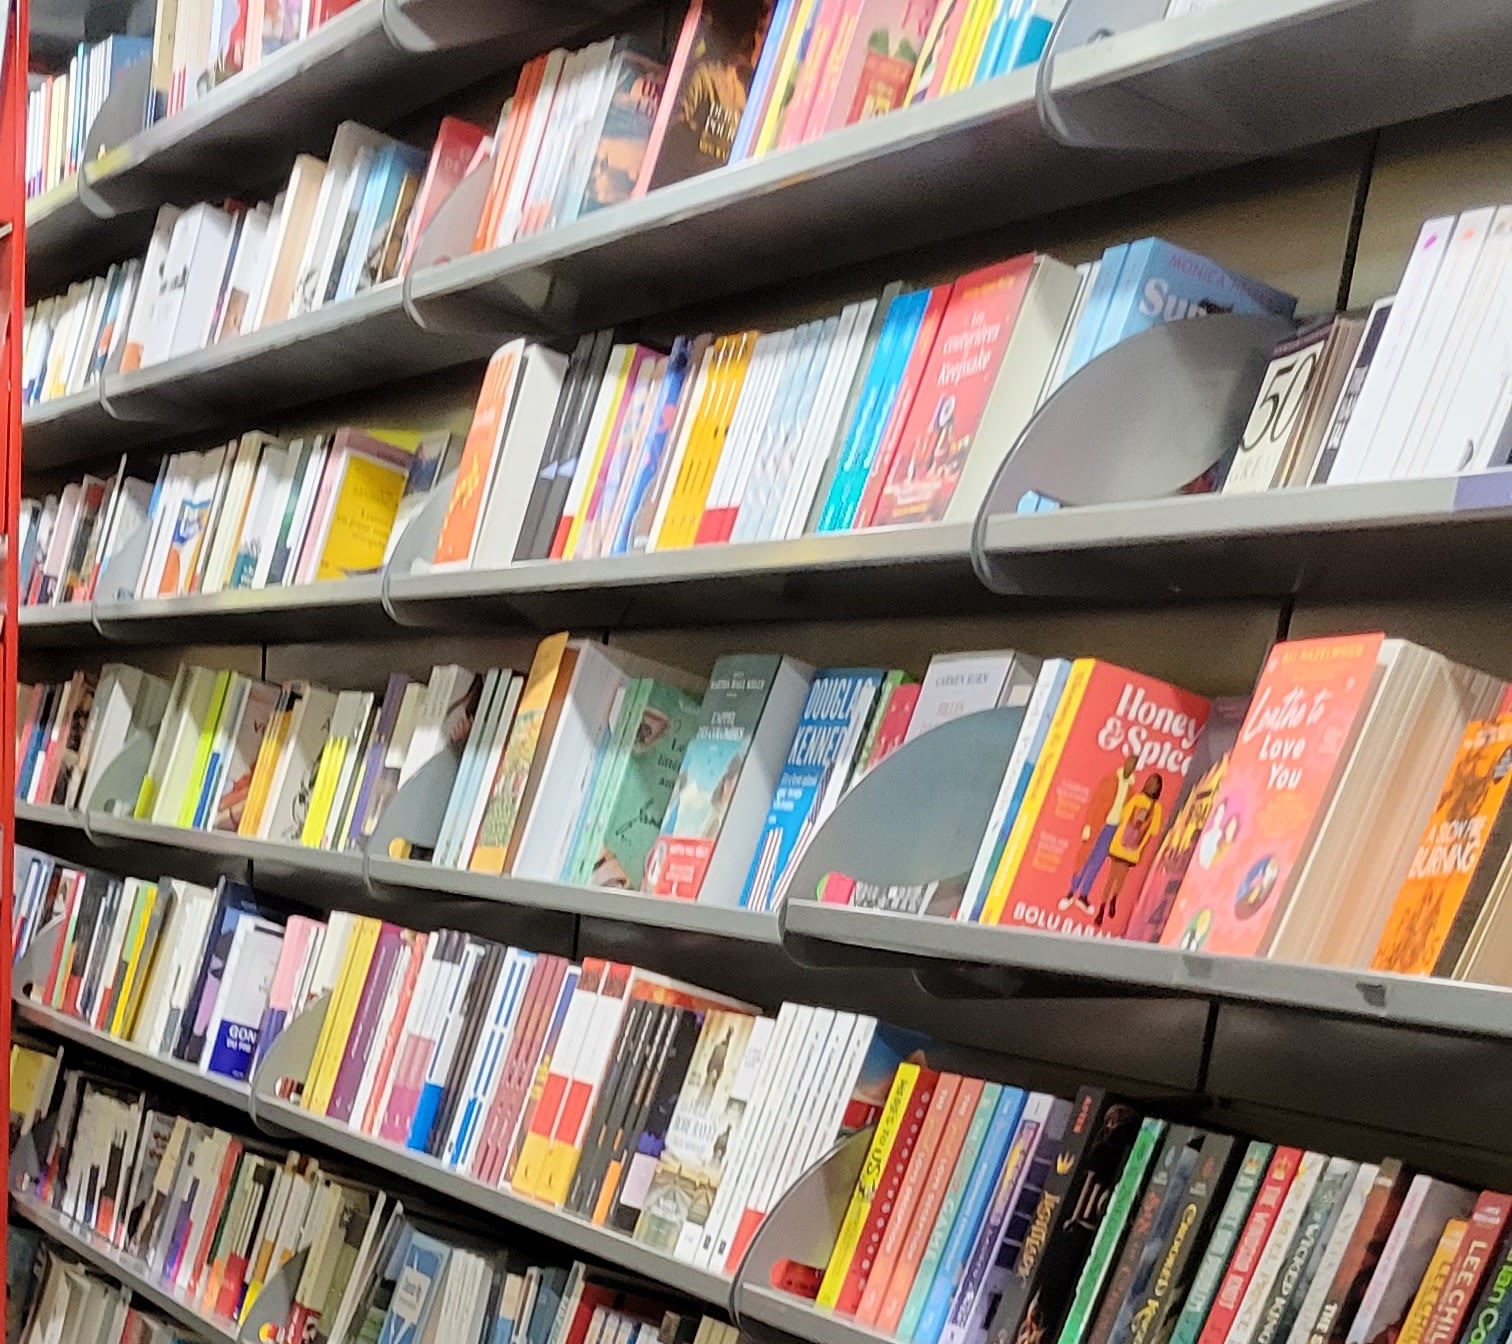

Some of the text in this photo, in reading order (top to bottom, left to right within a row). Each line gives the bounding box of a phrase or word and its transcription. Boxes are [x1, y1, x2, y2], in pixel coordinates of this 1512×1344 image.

[1239, 352, 1318, 452] 50
[1115, 682, 1198, 749] Honey
[1258, 733, 1306, 790] Love You
[1407, 839, 1479, 880] BURNING
[1277, 1218, 1321, 1298] WICKED
[1455, 1238, 1488, 1288] LEE
[1314, 1299, 1338, 1335] THE
